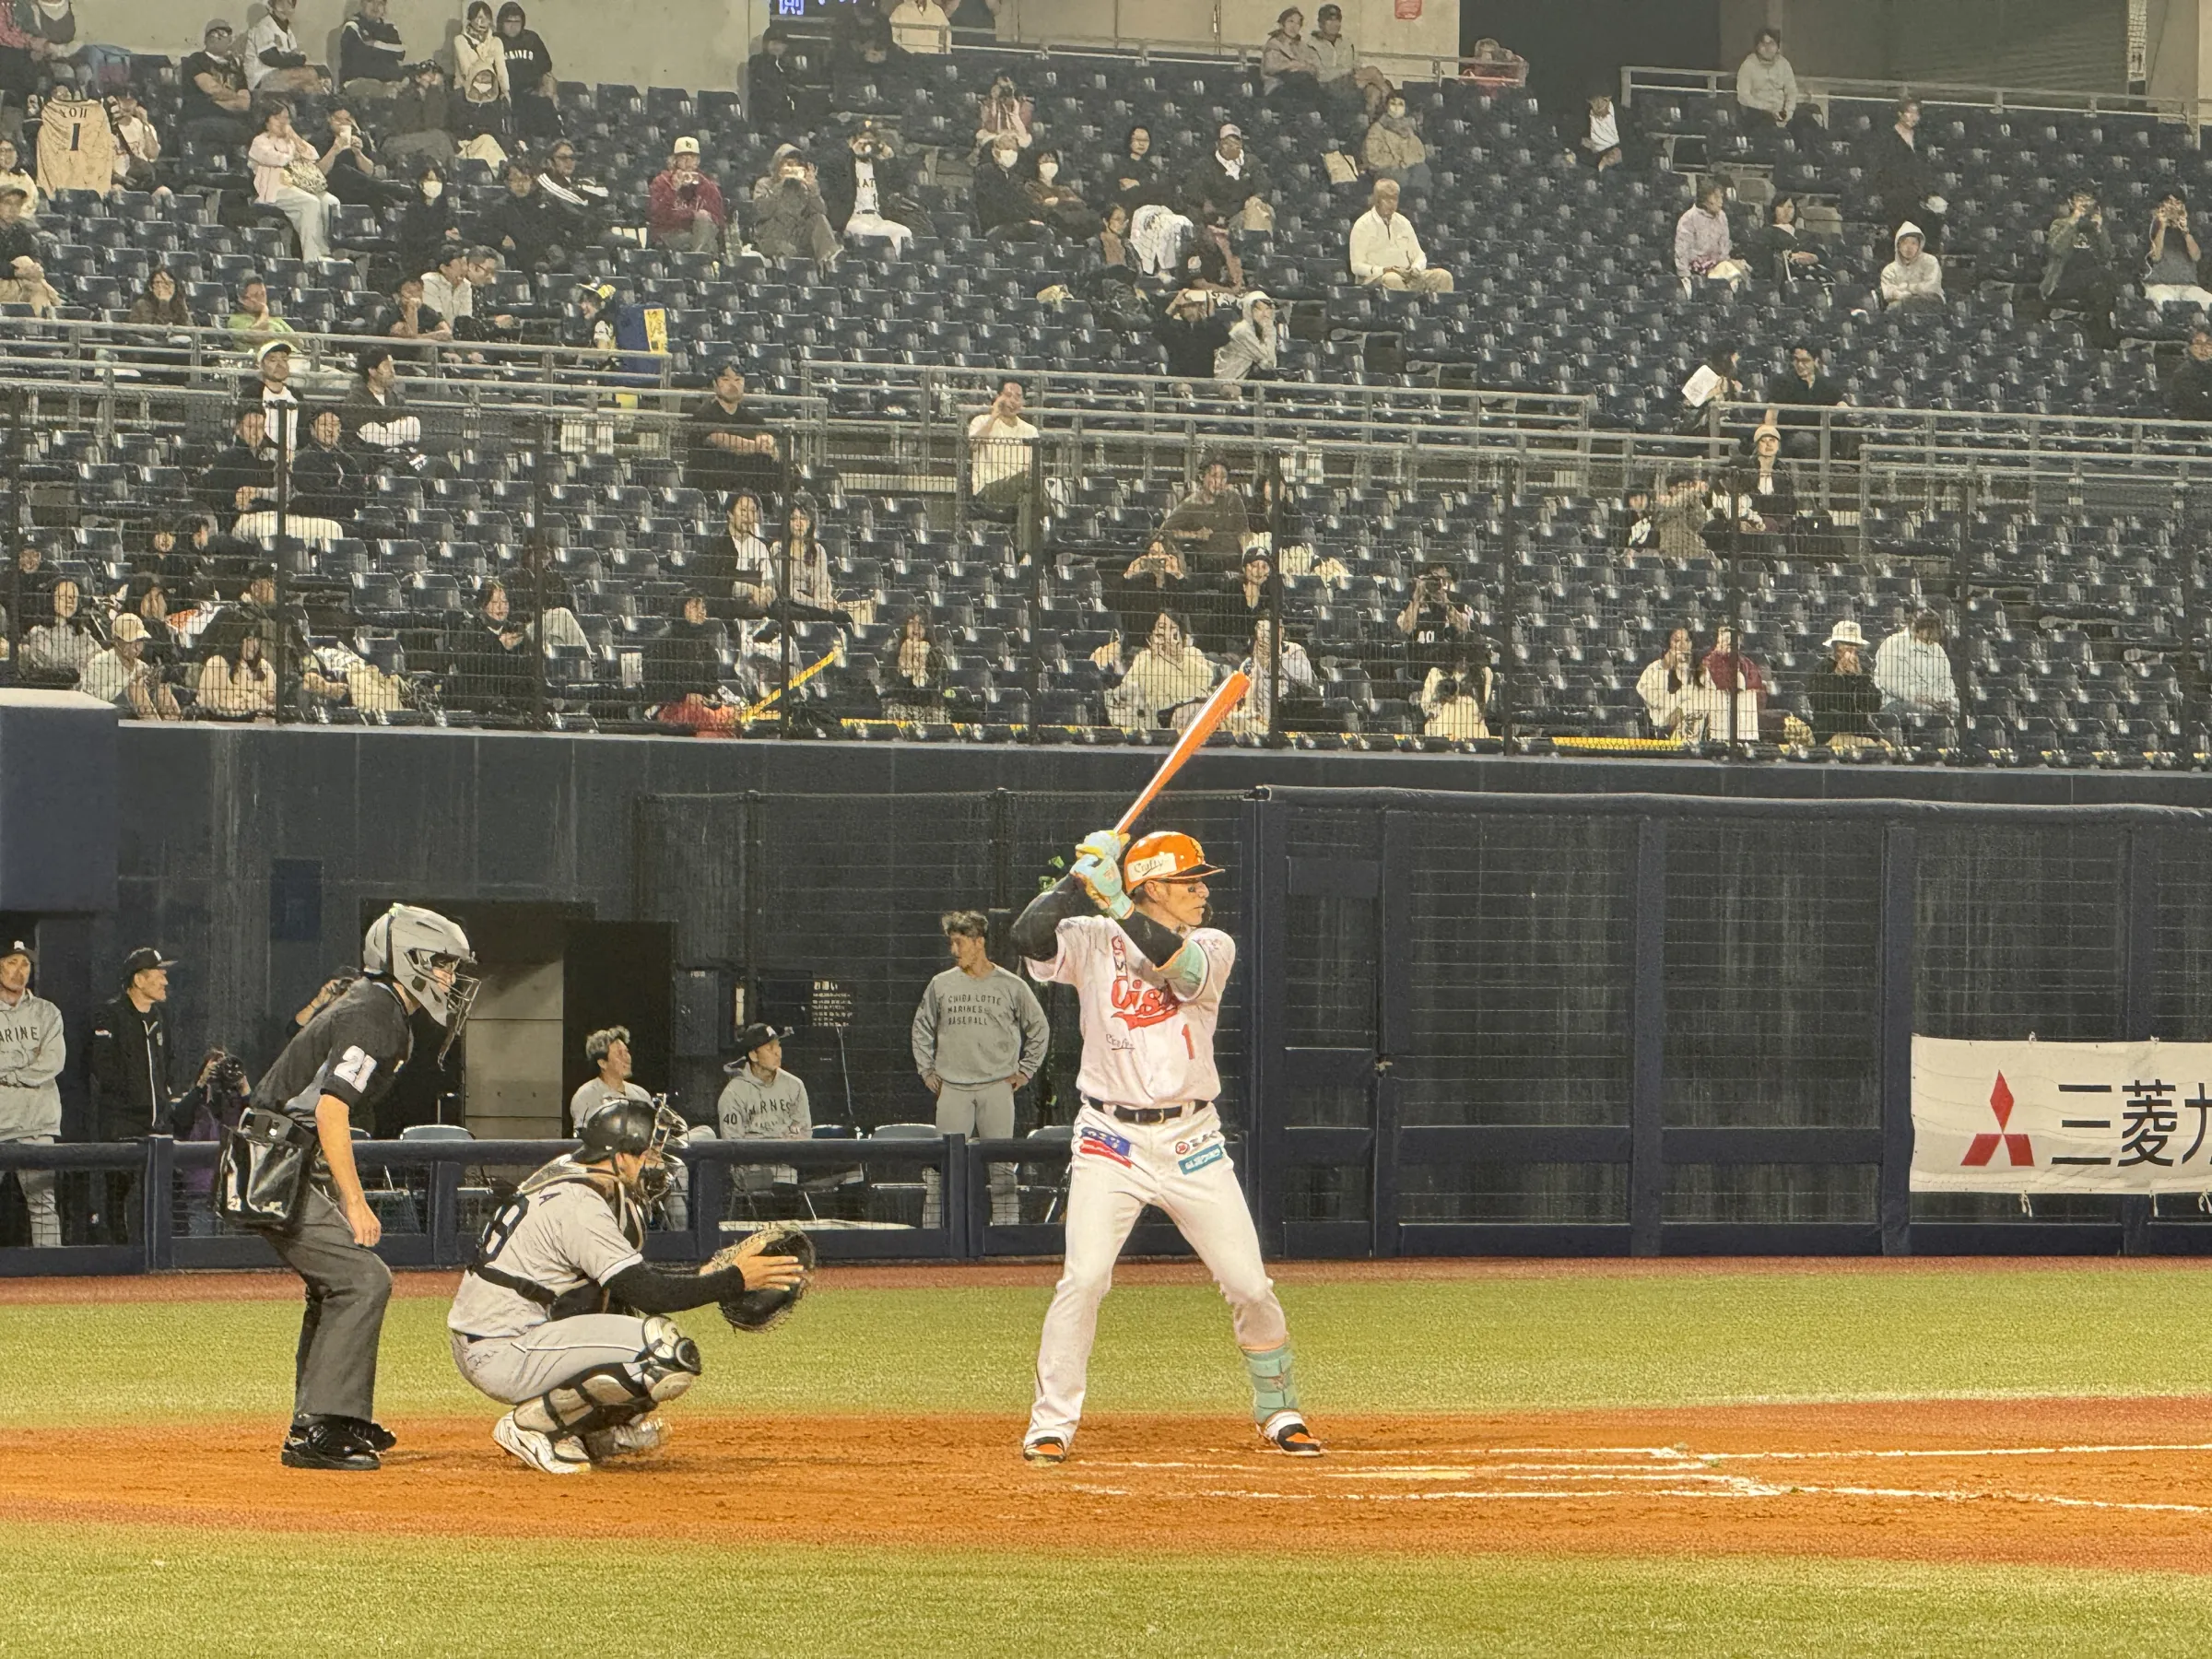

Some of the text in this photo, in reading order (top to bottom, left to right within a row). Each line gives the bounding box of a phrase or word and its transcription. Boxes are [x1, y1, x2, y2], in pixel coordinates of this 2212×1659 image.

[69, 123, 81, 152] 1
[975, 994, 1002, 1006] LOTTE
[947, 1006, 983, 1014] MARINES
[947, 1016, 988, 1026] BASEBALL
[1182, 1023, 1195, 1060] 1
[334, 1045, 378, 1094] 21
[724, 1112, 737, 1125] 40
